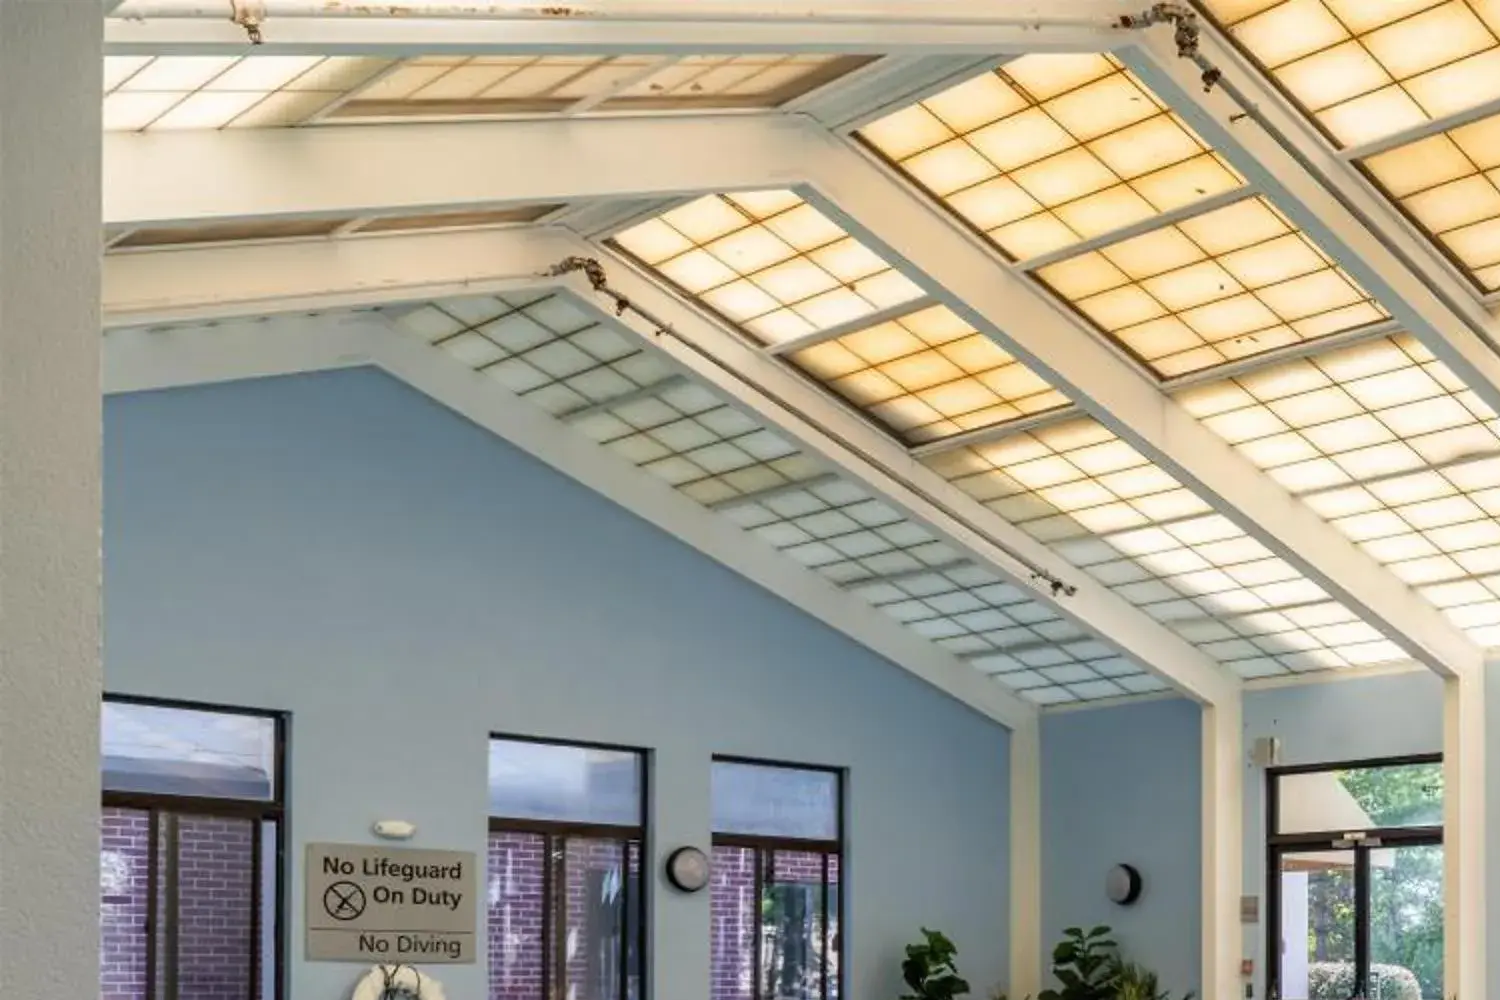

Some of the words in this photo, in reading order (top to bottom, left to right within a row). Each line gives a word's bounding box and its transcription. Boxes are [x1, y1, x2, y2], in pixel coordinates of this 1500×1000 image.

[323, 856, 354, 874] No
[363, 858, 462, 882] Lifeguard
[373, 886, 404, 904] On
[412, 887, 463, 911] Duty
[359, 935, 389, 953] No
[397, 935, 462, 959] Diving
